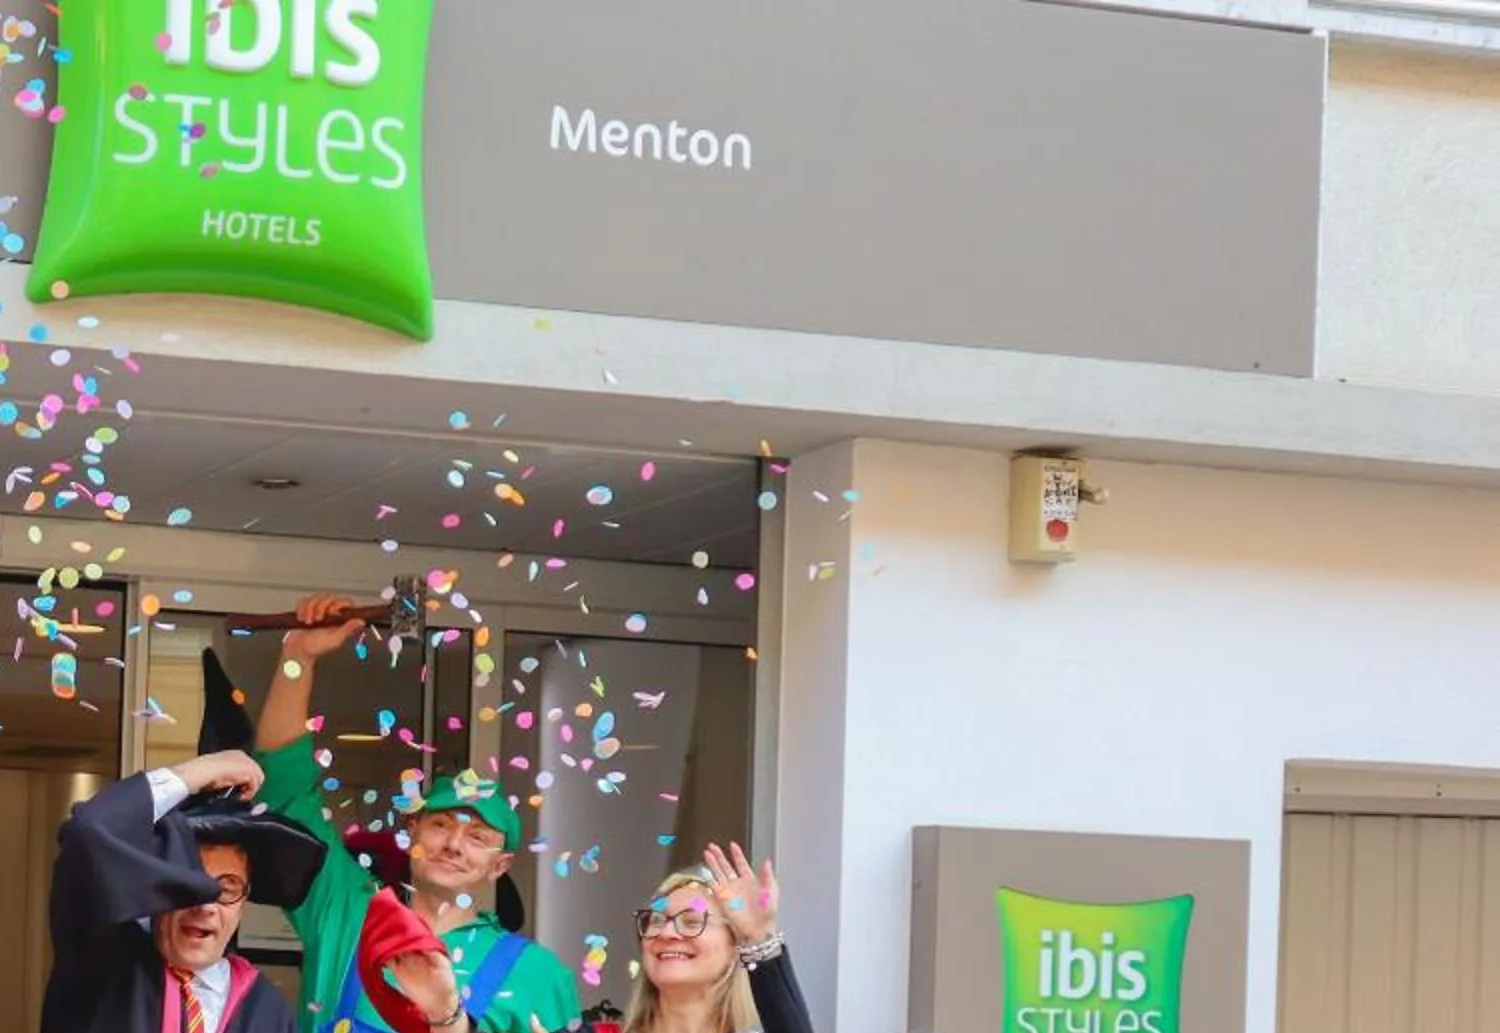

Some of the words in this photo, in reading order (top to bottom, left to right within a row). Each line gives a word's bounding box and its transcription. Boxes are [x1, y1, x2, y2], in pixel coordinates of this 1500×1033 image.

[550, 104, 751, 170] Menton
[202, 208, 322, 246] HOTELS
[1039, 929, 1147, 1001] ibis
